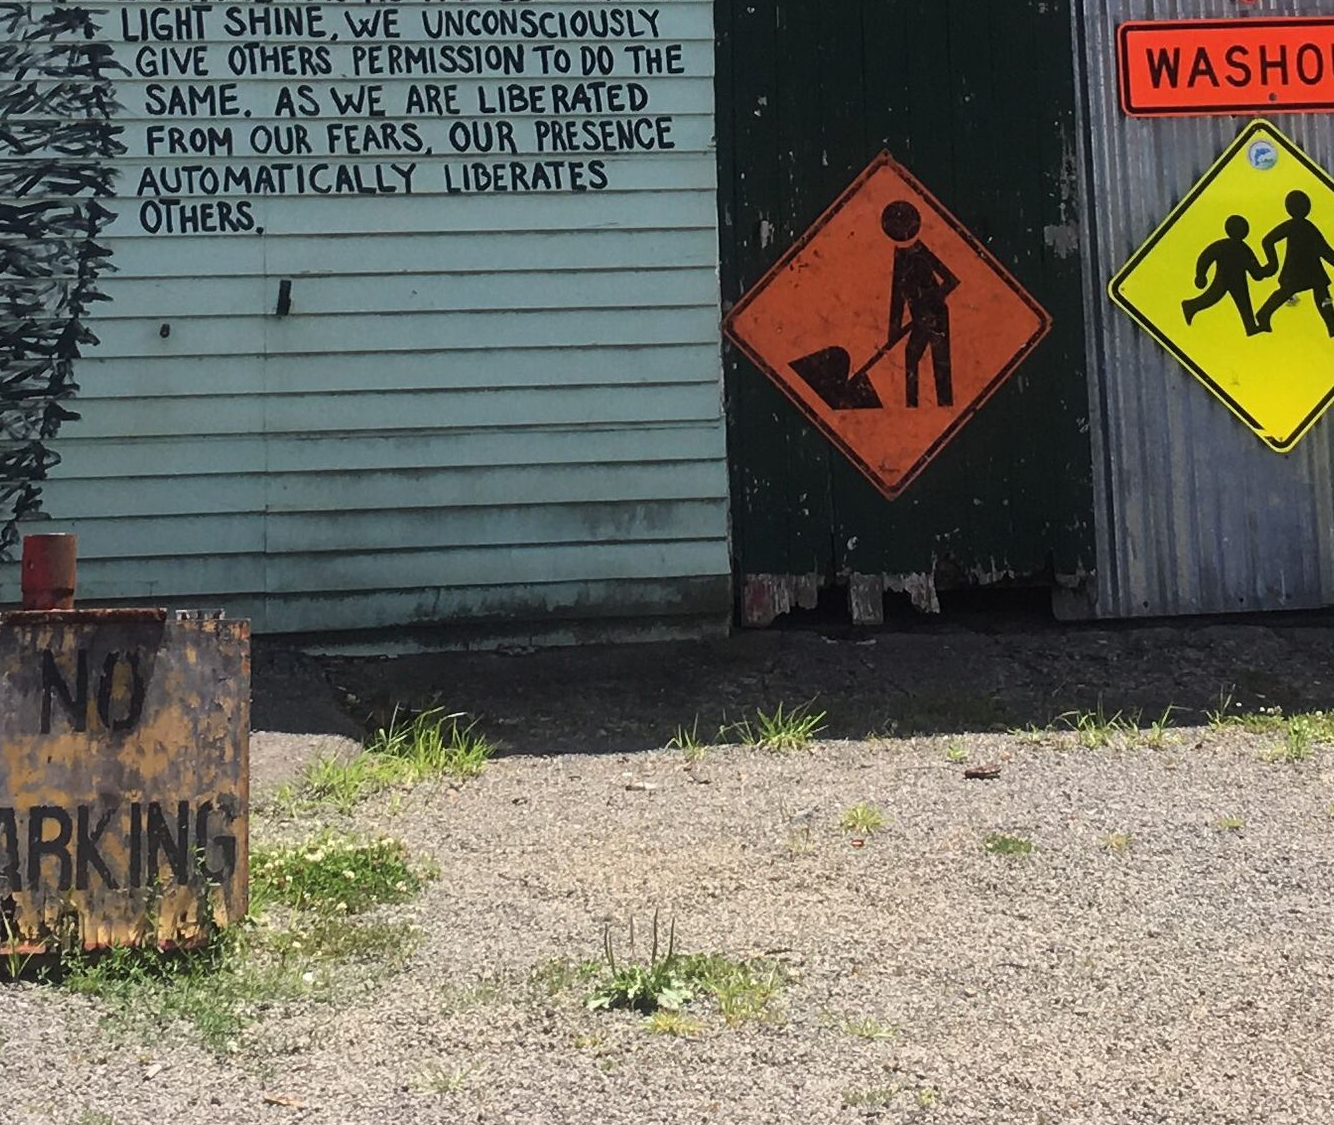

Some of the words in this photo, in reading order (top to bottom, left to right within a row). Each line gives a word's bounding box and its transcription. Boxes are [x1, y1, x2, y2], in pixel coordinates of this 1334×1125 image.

[121, 5, 213, 41] LIGHT
[344, 9, 401, 39] WE
[422, 8, 660, 39] UNCONSCIOUSLY
[136, 45, 208, 76] GIVE
[228, 42, 333, 75] OTHERS
[353, 44, 524, 74] PERMISSION
[532, 45, 571, 74] TO
[581, 45, 614, 76] DO
[624, 44, 685, 74] THE
[145, 83, 252, 118] SAME.
[275, 85, 320, 117] AS
[330, 85, 385, 117] WE
[406, 84, 460, 115] ARE
[478, 81, 648, 114] LIBERATED
[147, 126, 233, 156] FROM
[250, 125, 312, 155] OUR
[449, 122, 517, 155] OUR
[536, 117, 676, 152] PRESENCE
[137, 163, 416, 196] AUTOMATICALLY
[444, 161, 608, 194] LIBERATES
[40, 649, 147, 733] NO
